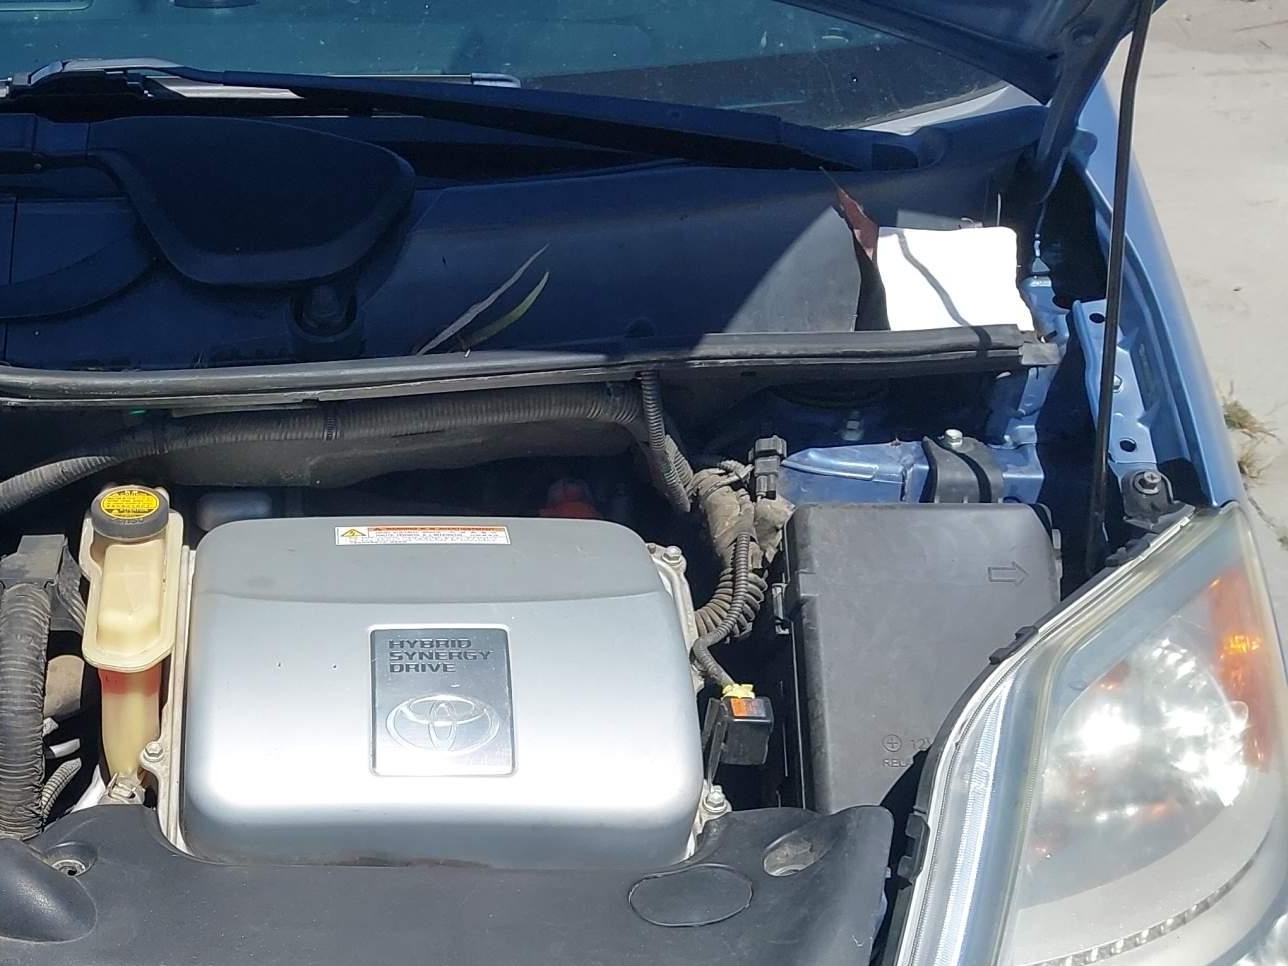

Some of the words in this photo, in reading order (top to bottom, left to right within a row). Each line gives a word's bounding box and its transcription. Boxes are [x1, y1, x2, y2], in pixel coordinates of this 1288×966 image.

[388, 638, 472, 649] HYBRID
[388, 650, 493, 661] SYNERGY
[389, 662, 457, 673] DRIVE
